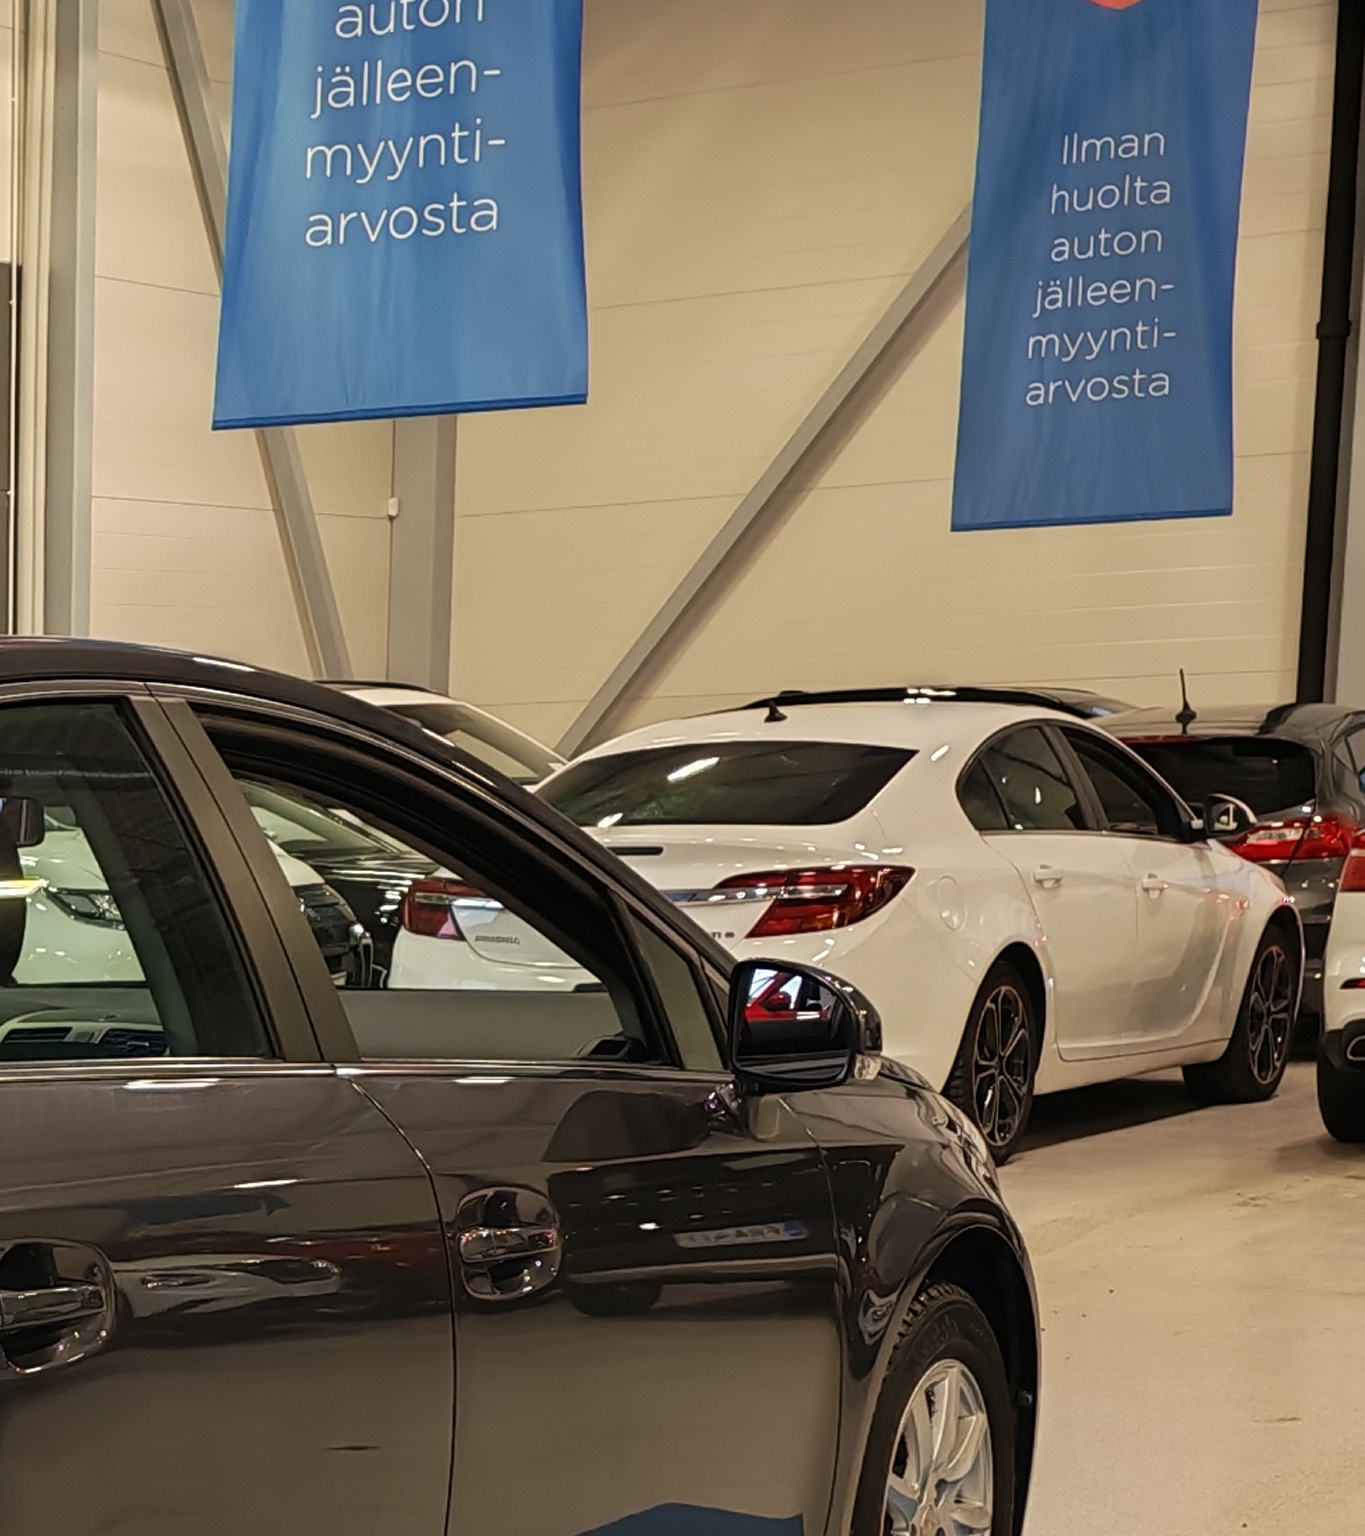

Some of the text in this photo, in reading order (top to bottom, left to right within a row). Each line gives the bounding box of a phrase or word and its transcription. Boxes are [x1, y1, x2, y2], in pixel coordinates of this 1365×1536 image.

[310, 58, 502, 119] jälleen-
[305, 117, 506, 184] myynti-
[1061, 130, 1166, 166] Ilman
[1049, 174, 1172, 215] huolta
[304, 191, 499, 247] arvosta
[1050, 226, 1163, 262] auton
[1031, 275, 1176, 319] jälleen-
[1027, 318, 1177, 364] myynti-
[1024, 367, 1170, 407] arvosta
